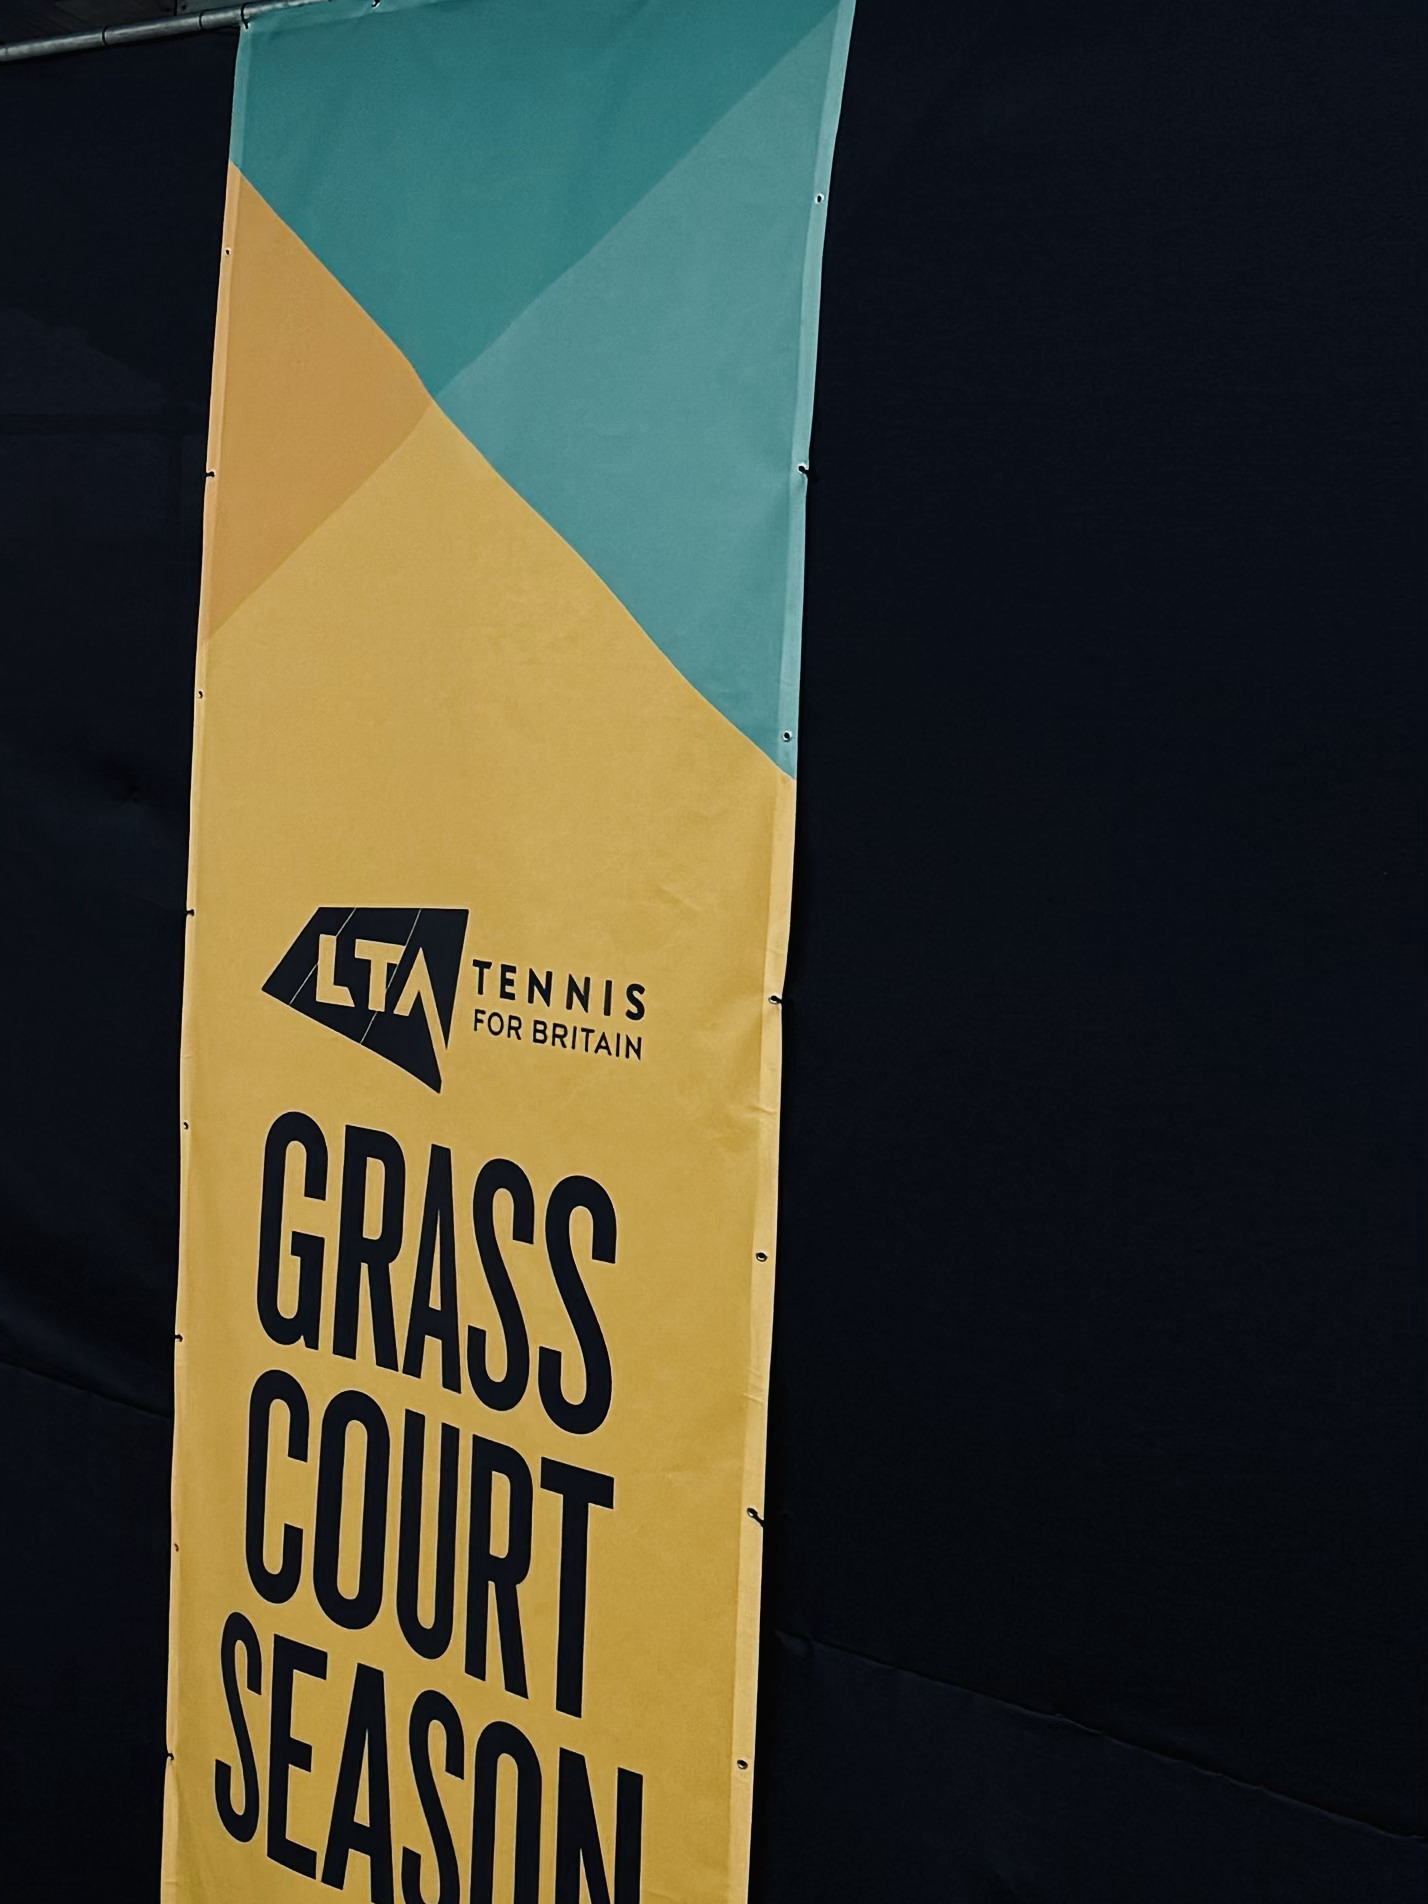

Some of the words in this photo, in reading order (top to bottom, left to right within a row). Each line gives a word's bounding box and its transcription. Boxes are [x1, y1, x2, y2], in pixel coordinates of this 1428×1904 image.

[315, 933, 448, 1050] LTA
[471, 958, 647, 1022] TENNIS
[472, 1009, 523, 1041] FOR
[531, 1021, 643, 1061] BRITAIN
[256, 1110, 618, 1436] GRASS
[245, 1369, 616, 1719] COURT
